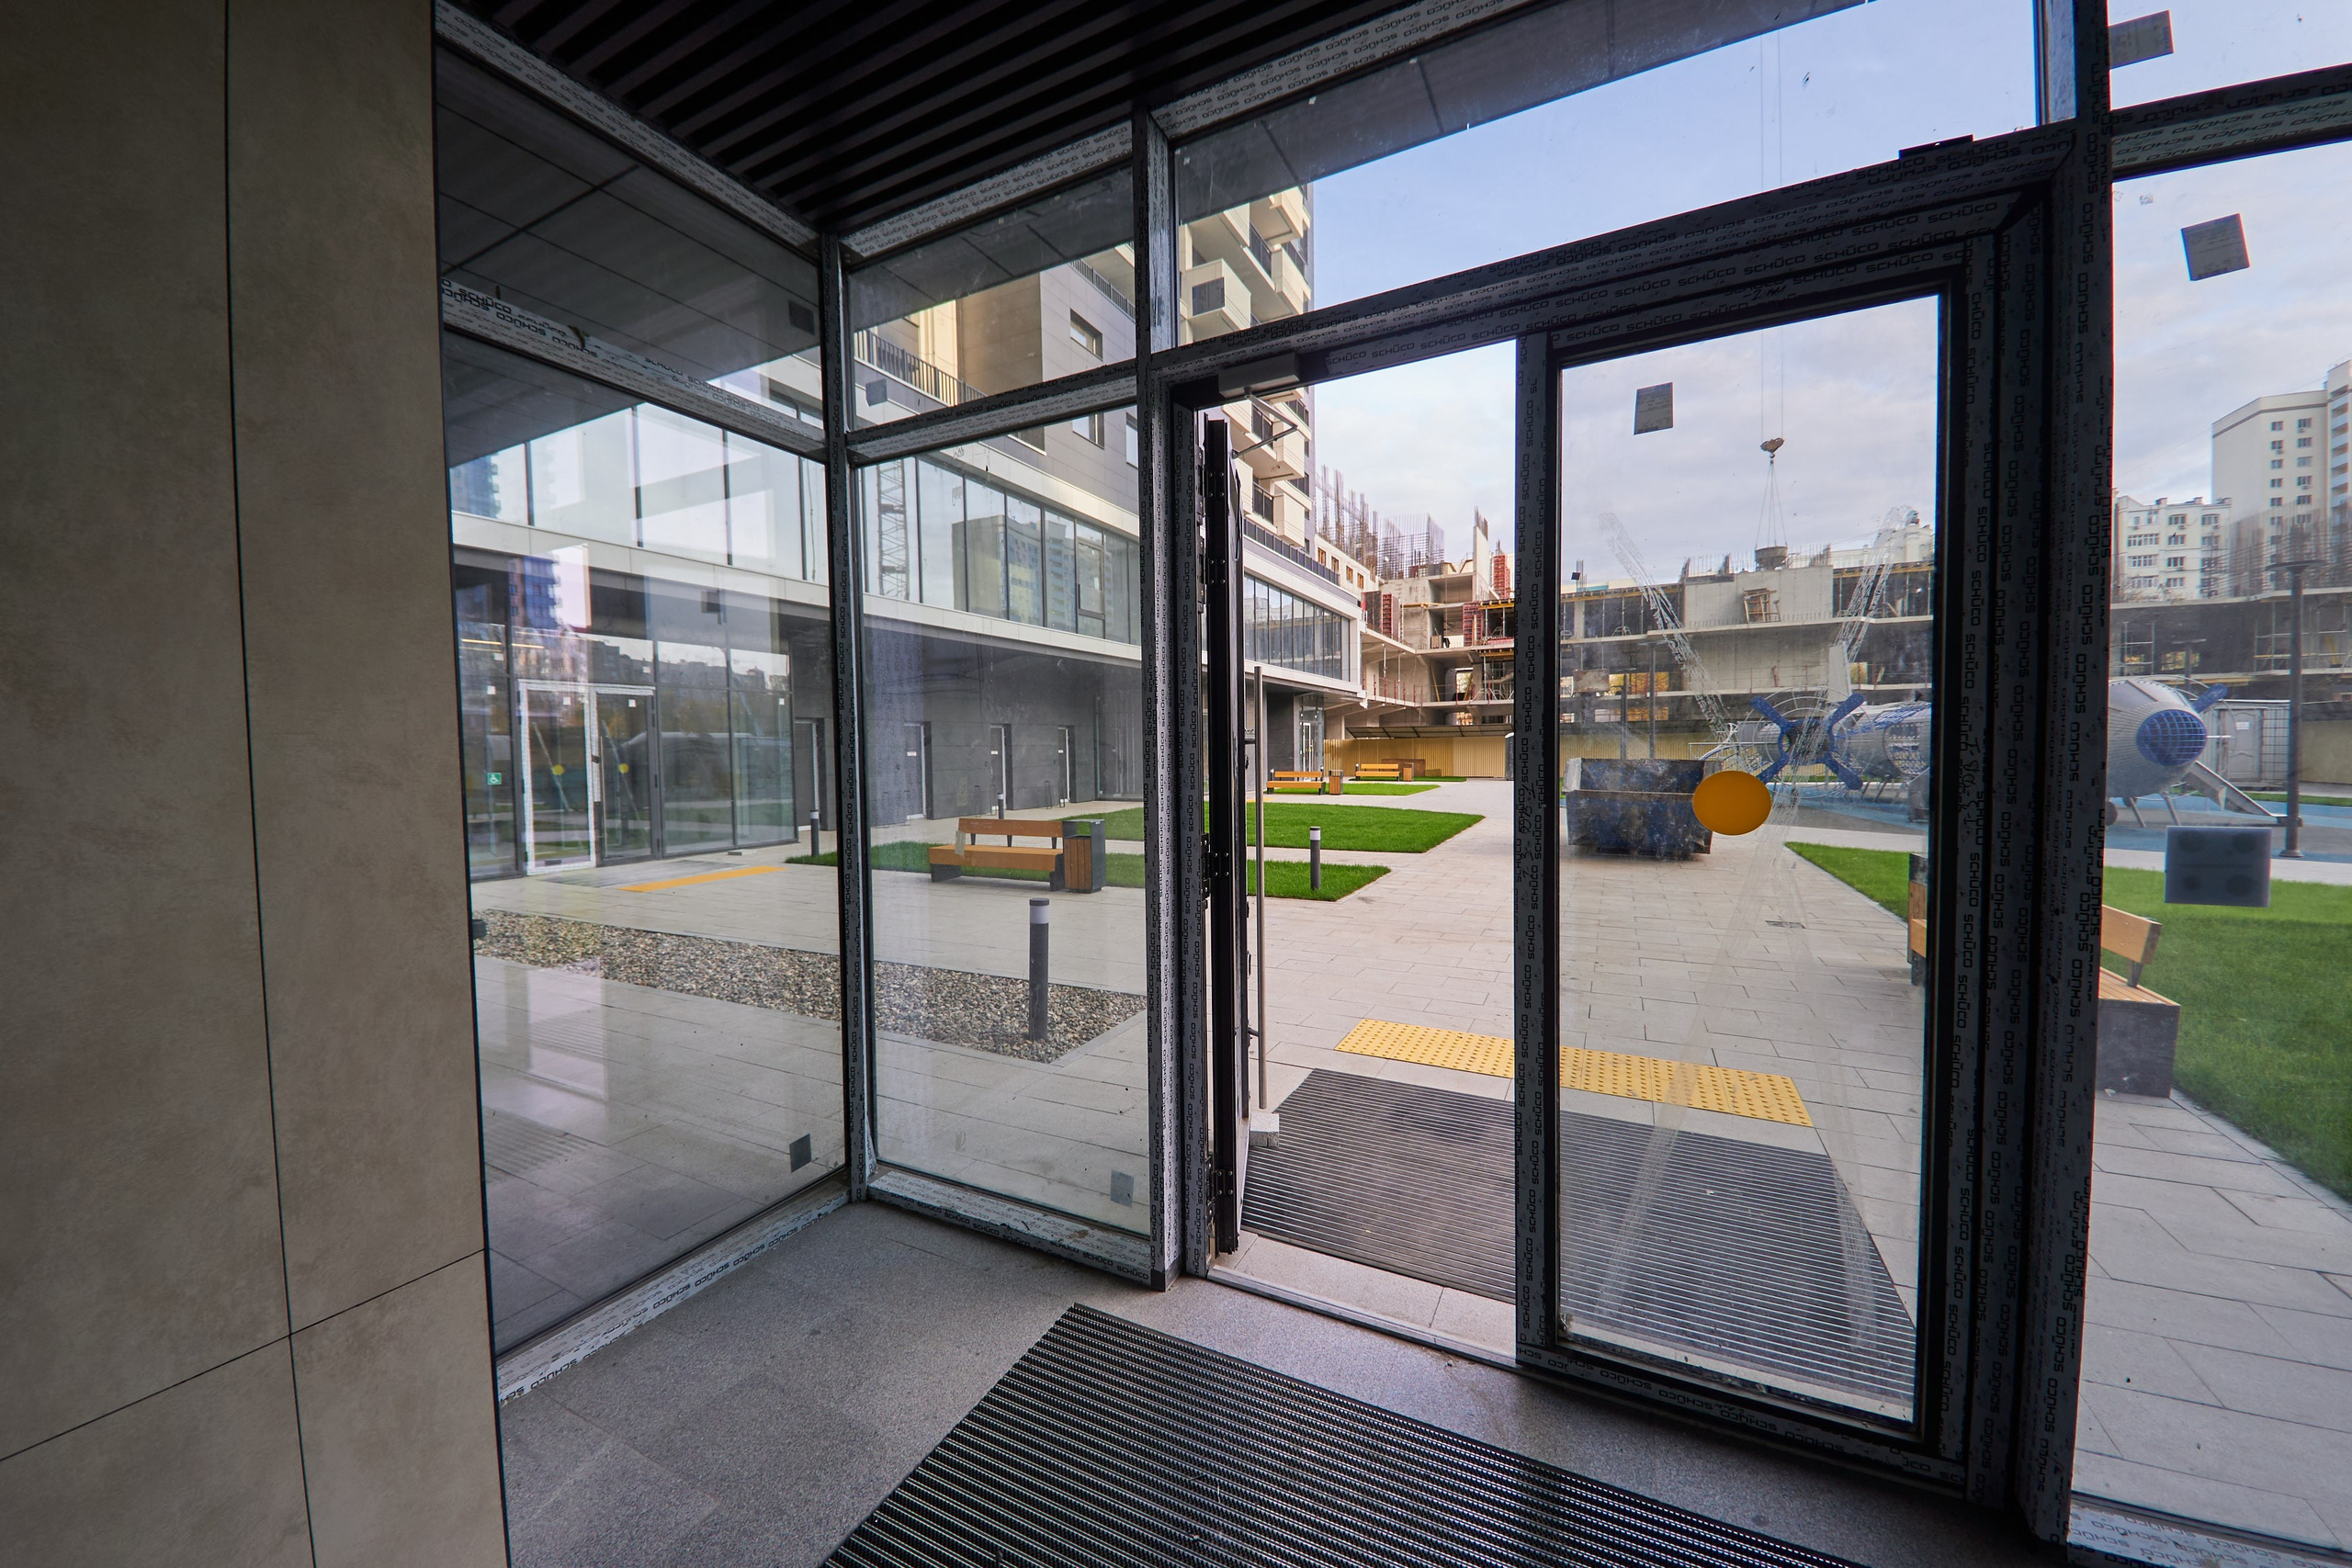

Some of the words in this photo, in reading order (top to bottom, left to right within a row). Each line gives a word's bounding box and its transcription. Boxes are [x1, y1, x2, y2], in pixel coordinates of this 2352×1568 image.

[2084, 133, 2098, 193] SCHÜCO
[1928, 202, 1996, 222] SCHÜCO
[2079, 203, 2093, 263] SCHÜCO
[1615, 279, 1669, 297] SCHÜCO
[1678, 267, 1736, 286] SCHÜCO
[1744, 254, 1804, 274] SCHÜCO
[1814, 243, 1878, 265] SCHÜCO
[1866, 248, 1933, 272] SCHÜCO
[2022, 264, 2035, 321] SCHÜCO
[1567, 323, 1619, 341] SCHÜCO
[1626, 313, 1681, 331] SCHÜCO
[2017, 330, 2030, 386] SCHÜCO
[1524, 400, 1533, 446] SCHÜCO
[2011, 395, 2024, 451] SCHÜCO
[1521, 454, 1529, 500] SCHÜCO
[2005, 460, 2018, 516] SCHÜCO
[1516, 506, 1525, 551] SCHÜCO
[1532, 531, 1542, 577] SCHÜCO
[1976, 506, 1988, 562] SCHÜCO
[1999, 525, 2012, 581] SCHÜCO
[2085, 514, 2099, 575] SCHÜCO
[1529, 583, 1538, 628] SCHÜCO
[1971, 570, 1983, 626] SCHÜCO
[2023, 557, 2038, 612] SCHÜCO
[2078, 584, 2093, 644] SCHÜCO
[1525, 636, 1534, 680] SCHÜCO
[1964, 634, 1976, 688] SCHÜCO
[2017, 621, 2030, 676] SCHÜCO
[1192, 667, 1200, 705] SCHÜCO
[1522, 686, 1532, 731] SCHÜCO
[2073, 653, 2086, 713] SCHÜCO
[1190, 710, 1198, 748] SCHÜCO
[2010, 685, 2024, 740] SCHÜCO
[1519, 738, 1528, 782] SCHÜCO
[2005, 749, 2018, 804] SCHÜCO
[2064, 722, 2080, 781] SCHÜCO
[1532, 814, 1542, 859] SCHÜCO
[1997, 812, 2011, 866] SCHÜCO
[1529, 865, 1538, 909] SCHÜCO
[1990, 874, 2004, 928] SCHÜCO
[1193, 941, 1202, 977] SCHÜCO
[1525, 915, 1534, 959] SCHÜCO
[1962, 914, 1975, 967] SCHÜCO
[2067, 959, 2082, 1017] SCHÜCO
[2075, 893, 2089, 951] SCHÜCO
[1521, 964, 1531, 1009] SCHÜCO
[1957, 975, 1969, 1028] SCHÜCO
[2007, 969, 2021, 1023] SCHÜCO
[1519, 1014, 1528, 1057] SCHÜCO
[2001, 1031, 2014, 1084] SCHÜCO
[1515, 1063, 1525, 1106] SCHÜCO
[1532, 1091, 1542, 1134] SCHÜCO
[1995, 1091, 2007, 1145] SCHÜCO
[1196, 1168, 1204, 1204] SCHÜCO
[1530, 1140, 1539, 1184] SCHÜCO
[1987, 1151, 2000, 1203] SCHÜCO
[1526, 1189, 1535, 1233] SCHÜCO
[1959, 1188, 1972, 1240] SCHÜCO
[1981, 1210, 1994, 1262] SCHÜCO
[1523, 1237, 1532, 1280] SCHÜCO
[1953, 1247, 1965, 1298] SCHÜCO
[1521, 1285, 1530, 1328] SCHÜCO
[1948, 1304, 1960, 1354] SCHÜCO
[1980, 1417, 1993, 1469] SCHÜCO
[1988, 1361, 2001, 1412] SCHÜCO
[1996, 1303, 2009, 1356] SCHÜCO
[2004, 1246, 2017, 1297] SCHÜCO
[2043, 1378, 2057, 1432] SCHÜCO
[2052, 1317, 2066, 1371] SCHÜCO
[2061, 1255, 2075, 1310] SCHÜCO
